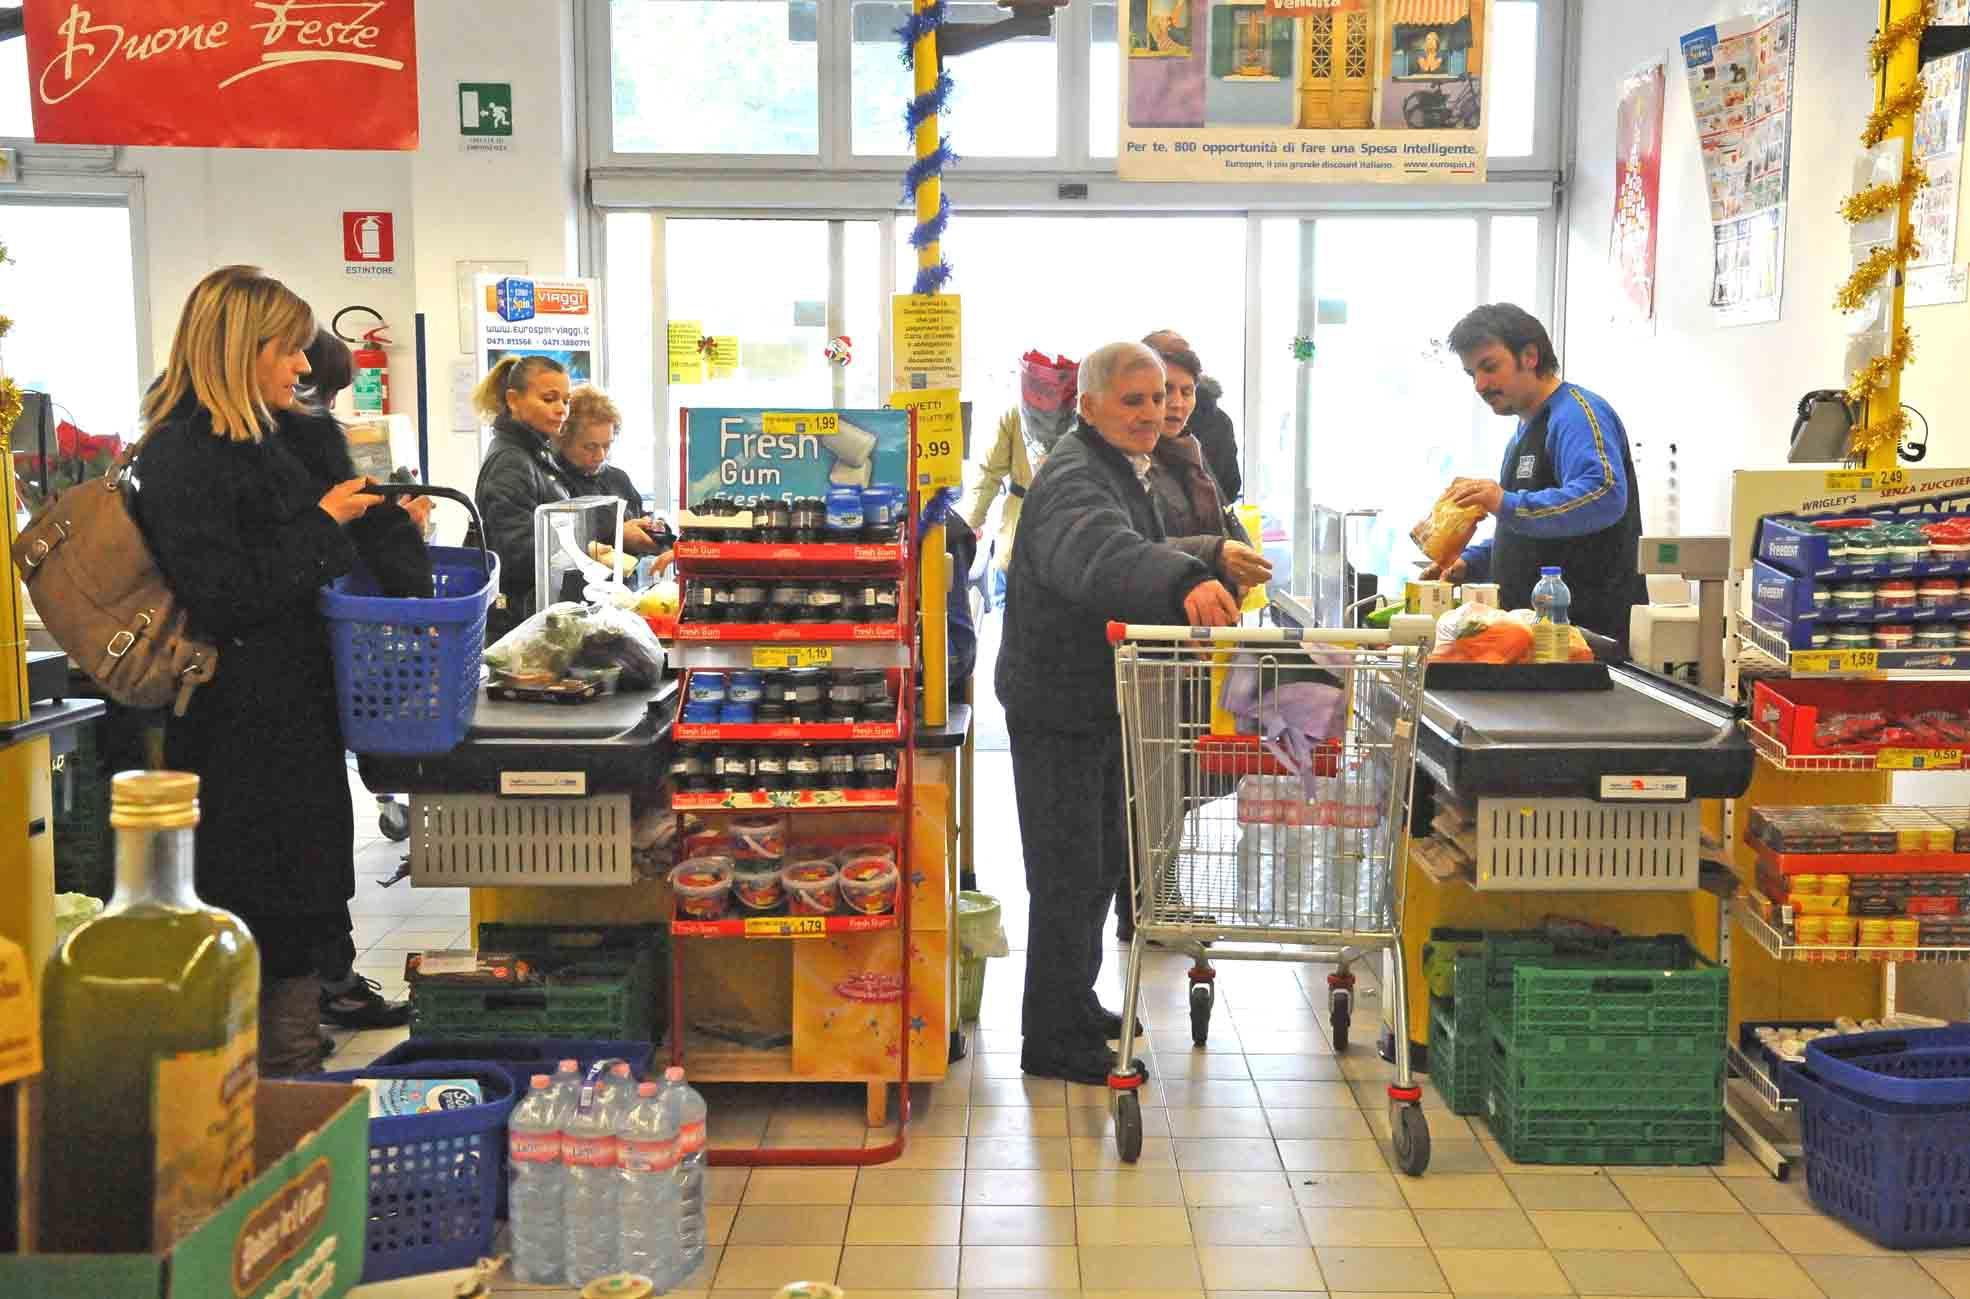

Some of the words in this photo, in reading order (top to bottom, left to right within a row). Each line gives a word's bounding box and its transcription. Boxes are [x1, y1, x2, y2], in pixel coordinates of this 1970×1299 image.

[40, 4, 229, 104] Buone
[251, 0, 386, 49] Feste
[1127, 142, 1147, 152] Per
[1175, 143, 1197, 152] 800
[1202, 142, 1277, 155] opportunità
[1283, 142, 1295, 153] di
[1301, 142, 1325, 153] fare
[1332, 144, 1355, 153] una
[1361, 144, 1397, 155] Spesa
[1290, 160, 1320, 169] grande
[1322, 160, 1358, 168] discount
[816, 416, 835, 430] 1,99
[721, 459, 781, 486] Gum
[1881, 470, 1903, 484] 2,49
[1880, 485, 1916, 498] SENZA
[1802, 494, 1857, 511] WRIGLEY'S
[1851, 652, 1874, 665] 1,59
